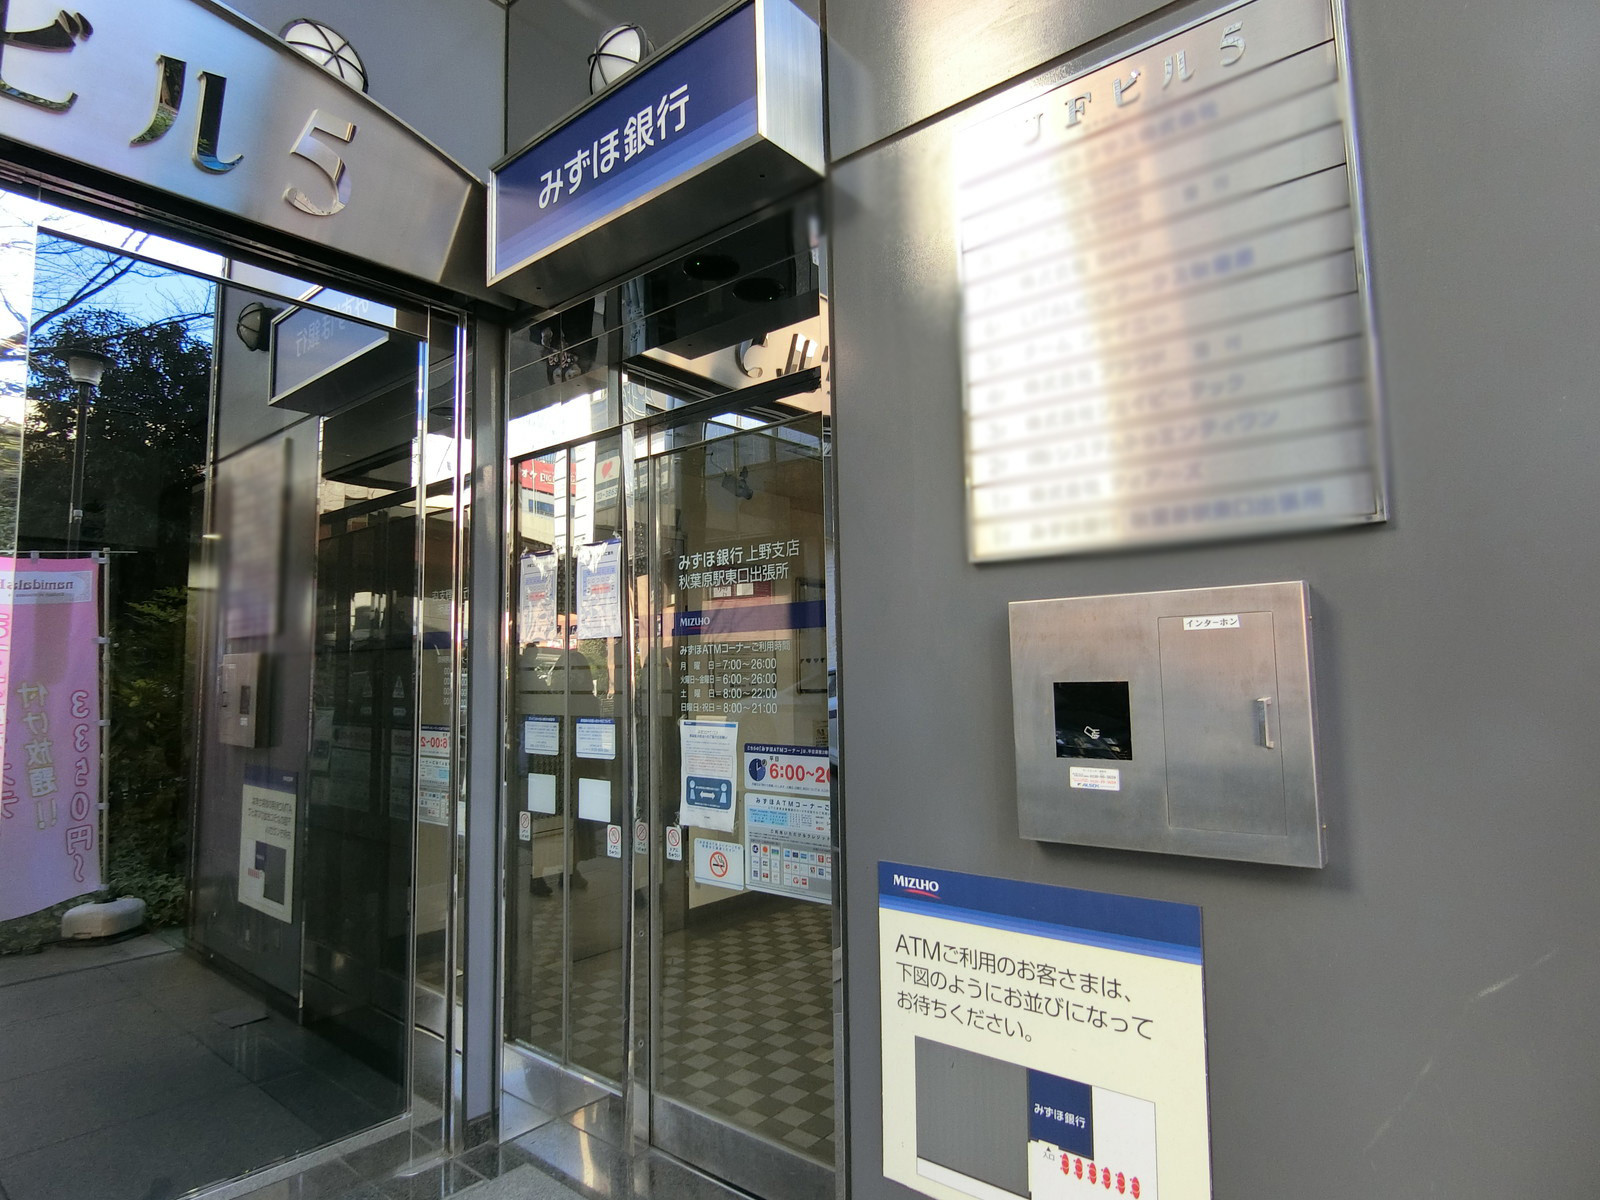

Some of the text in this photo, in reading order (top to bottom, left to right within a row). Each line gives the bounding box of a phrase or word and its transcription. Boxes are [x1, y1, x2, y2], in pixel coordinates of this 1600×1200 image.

[537, 83, 690, 210] みずほ銀行
[679, 539, 800, 570] みずほ銀行 上野支店
[678, 562, 789, 590] 秋葉原駅東口出張所
[680, 616, 711, 627] MIZUHO
[1185, 616, 1238, 629] インターホン
[679, 640, 791, 655] みずほATMコーナーご利用時間
[892, 874, 939, 893] MIZUHO
[895, 932, 1132, 1004] ATMご利用のお客さまは、
[895, 961, 1155, 1041] 下図のようにお並びになって
[896, 990, 1033, 1043] お待ちください。
[1033, 1102, 1087, 1130] みずほ銀行
[1043, 1151, 1055, 1162] 入口
